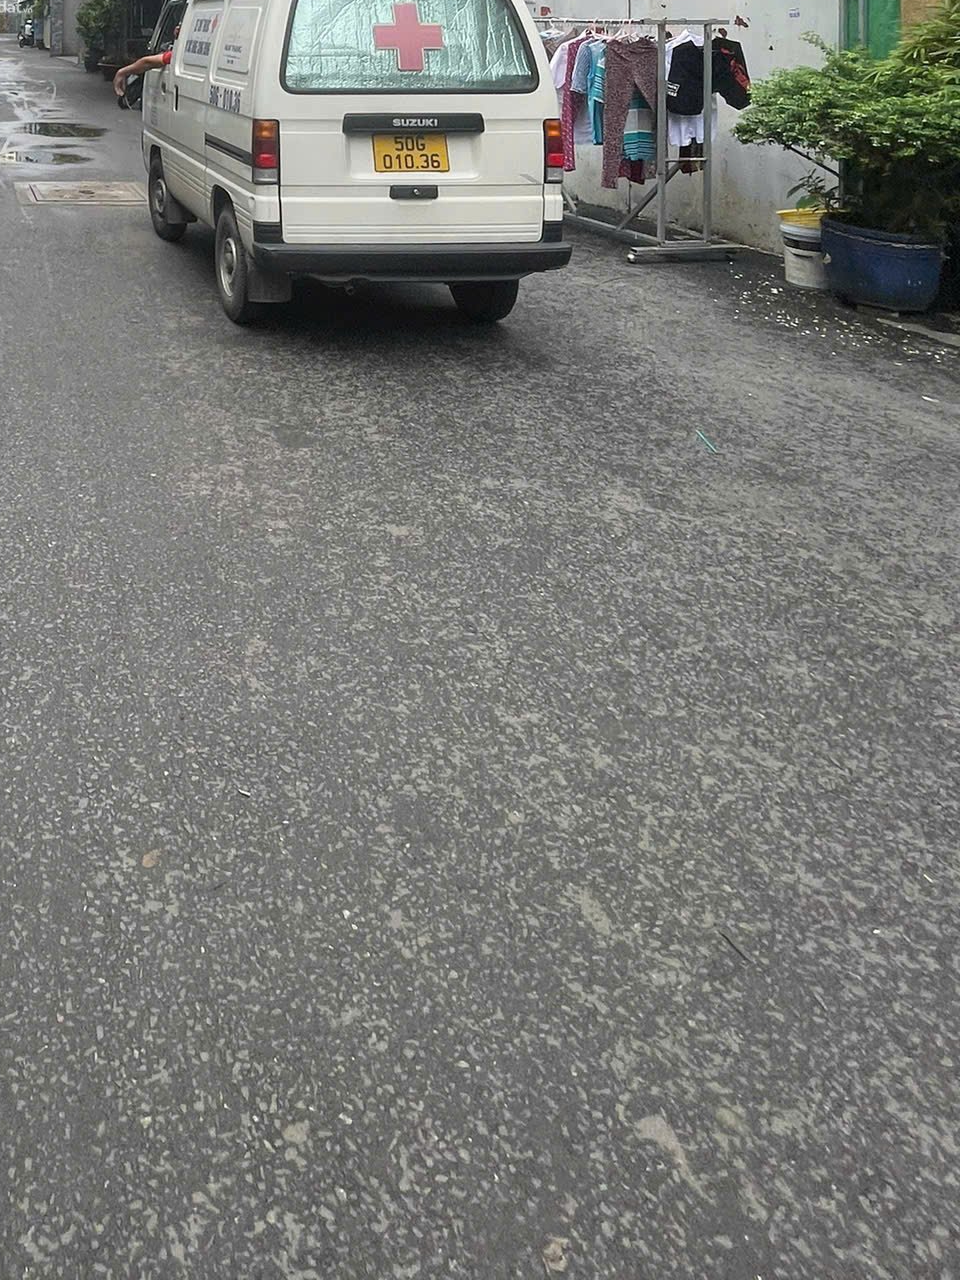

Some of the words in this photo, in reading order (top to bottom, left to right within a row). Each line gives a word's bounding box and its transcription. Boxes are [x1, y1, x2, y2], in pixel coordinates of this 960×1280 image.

[392, 118, 438, 127] SUZUKI
[394, 136, 426, 151] 50G
[383, 154, 441, 169] 010.36
